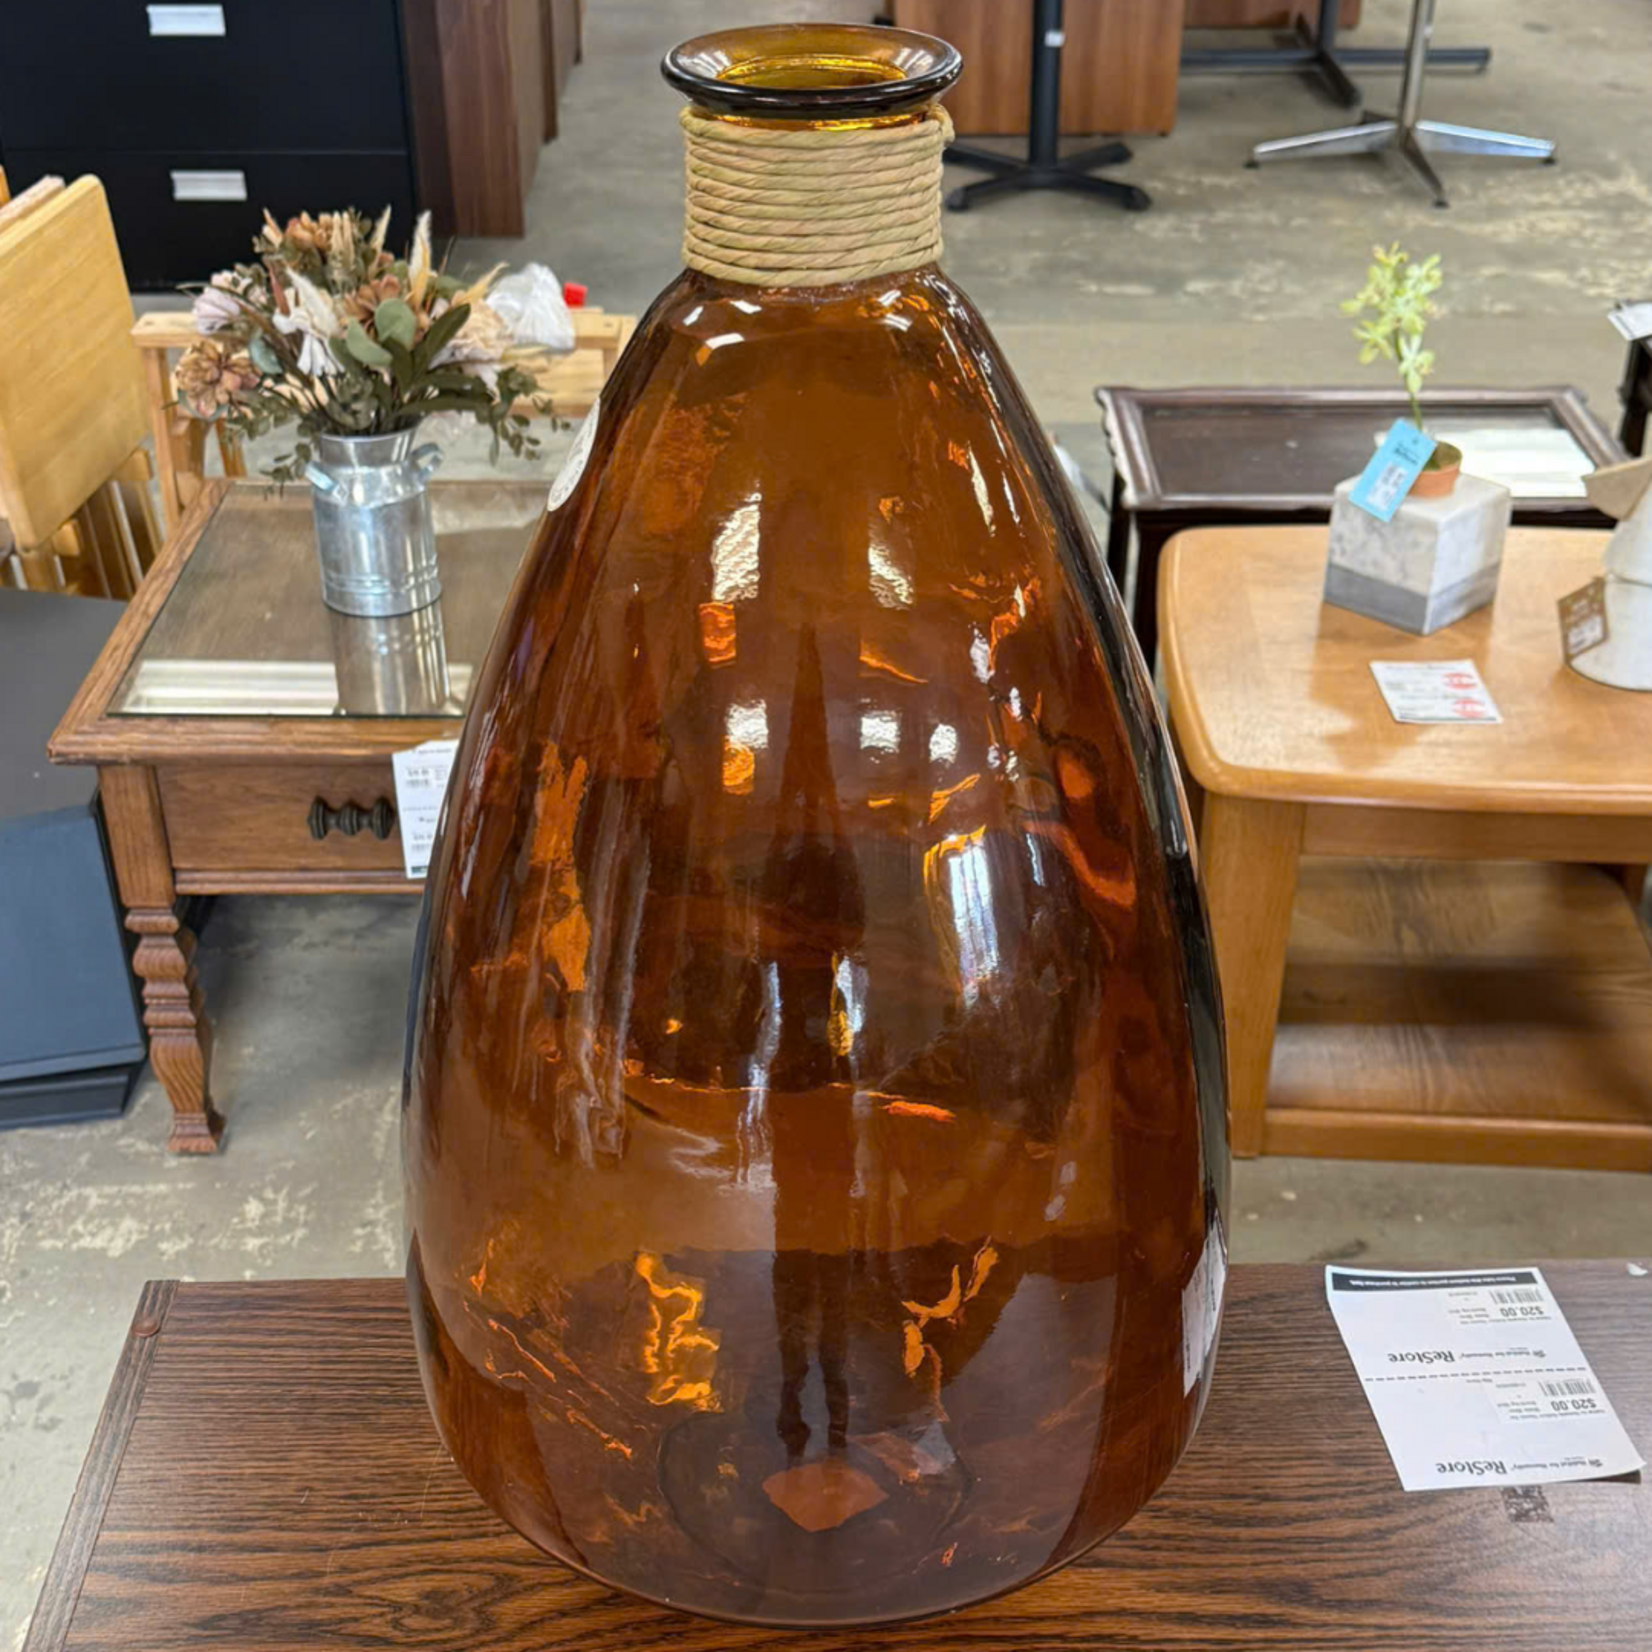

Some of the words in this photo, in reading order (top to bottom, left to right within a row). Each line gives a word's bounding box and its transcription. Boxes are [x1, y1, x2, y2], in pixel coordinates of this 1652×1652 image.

[1499, 1305, 1544, 1318] $20.00
[1387, 1350, 1456, 1364] ReStore
[1550, 1397, 1597, 1412] $20.00
[1435, 1460, 1508, 1475] ReStore
